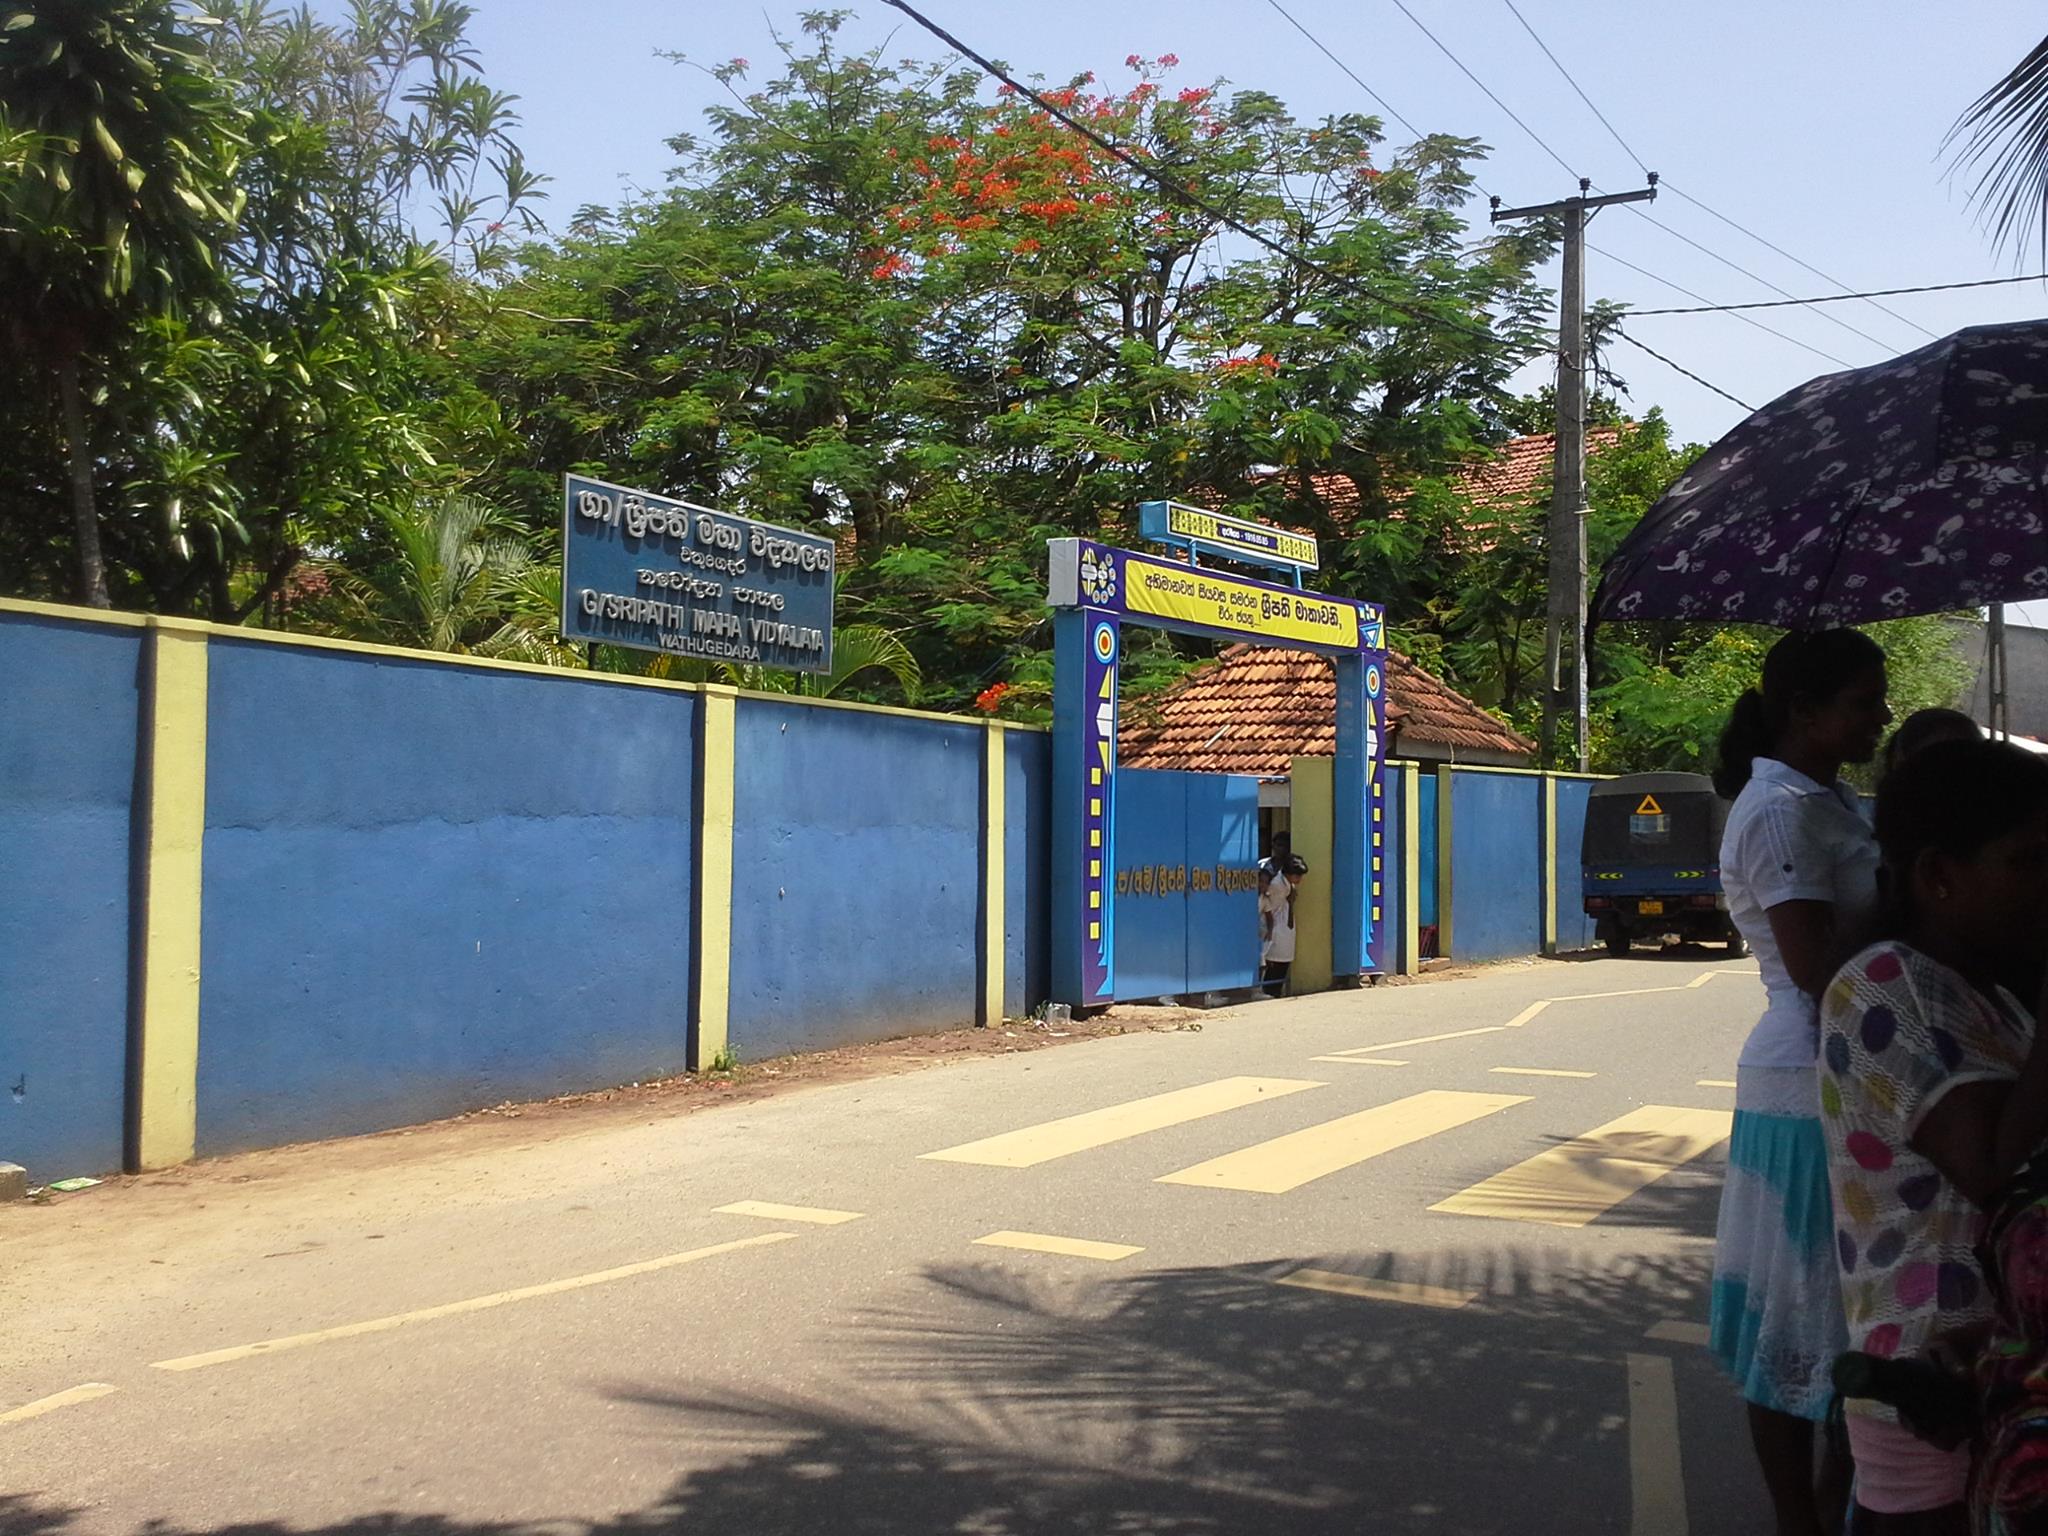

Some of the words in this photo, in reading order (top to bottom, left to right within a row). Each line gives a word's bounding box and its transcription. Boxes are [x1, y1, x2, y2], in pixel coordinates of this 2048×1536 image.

[696, 513, 742, 551] මහා
[749, 524, 831, 571] විද්‍යාලය
[732, 585, 785, 612] පාසල
[1198, 583, 1226, 603] සියවස
[1230, 591, 1258, 609] සමරන
[1261, 593, 1291, 620] ශ්‍රීපති
[581, 588, 685, 629] G/SRIPATHI
[692, 608, 743, 638] MAHA
[748, 617, 825, 652] VIDYALAYA
[659, 632, 761, 661] WATHUGEDARA
